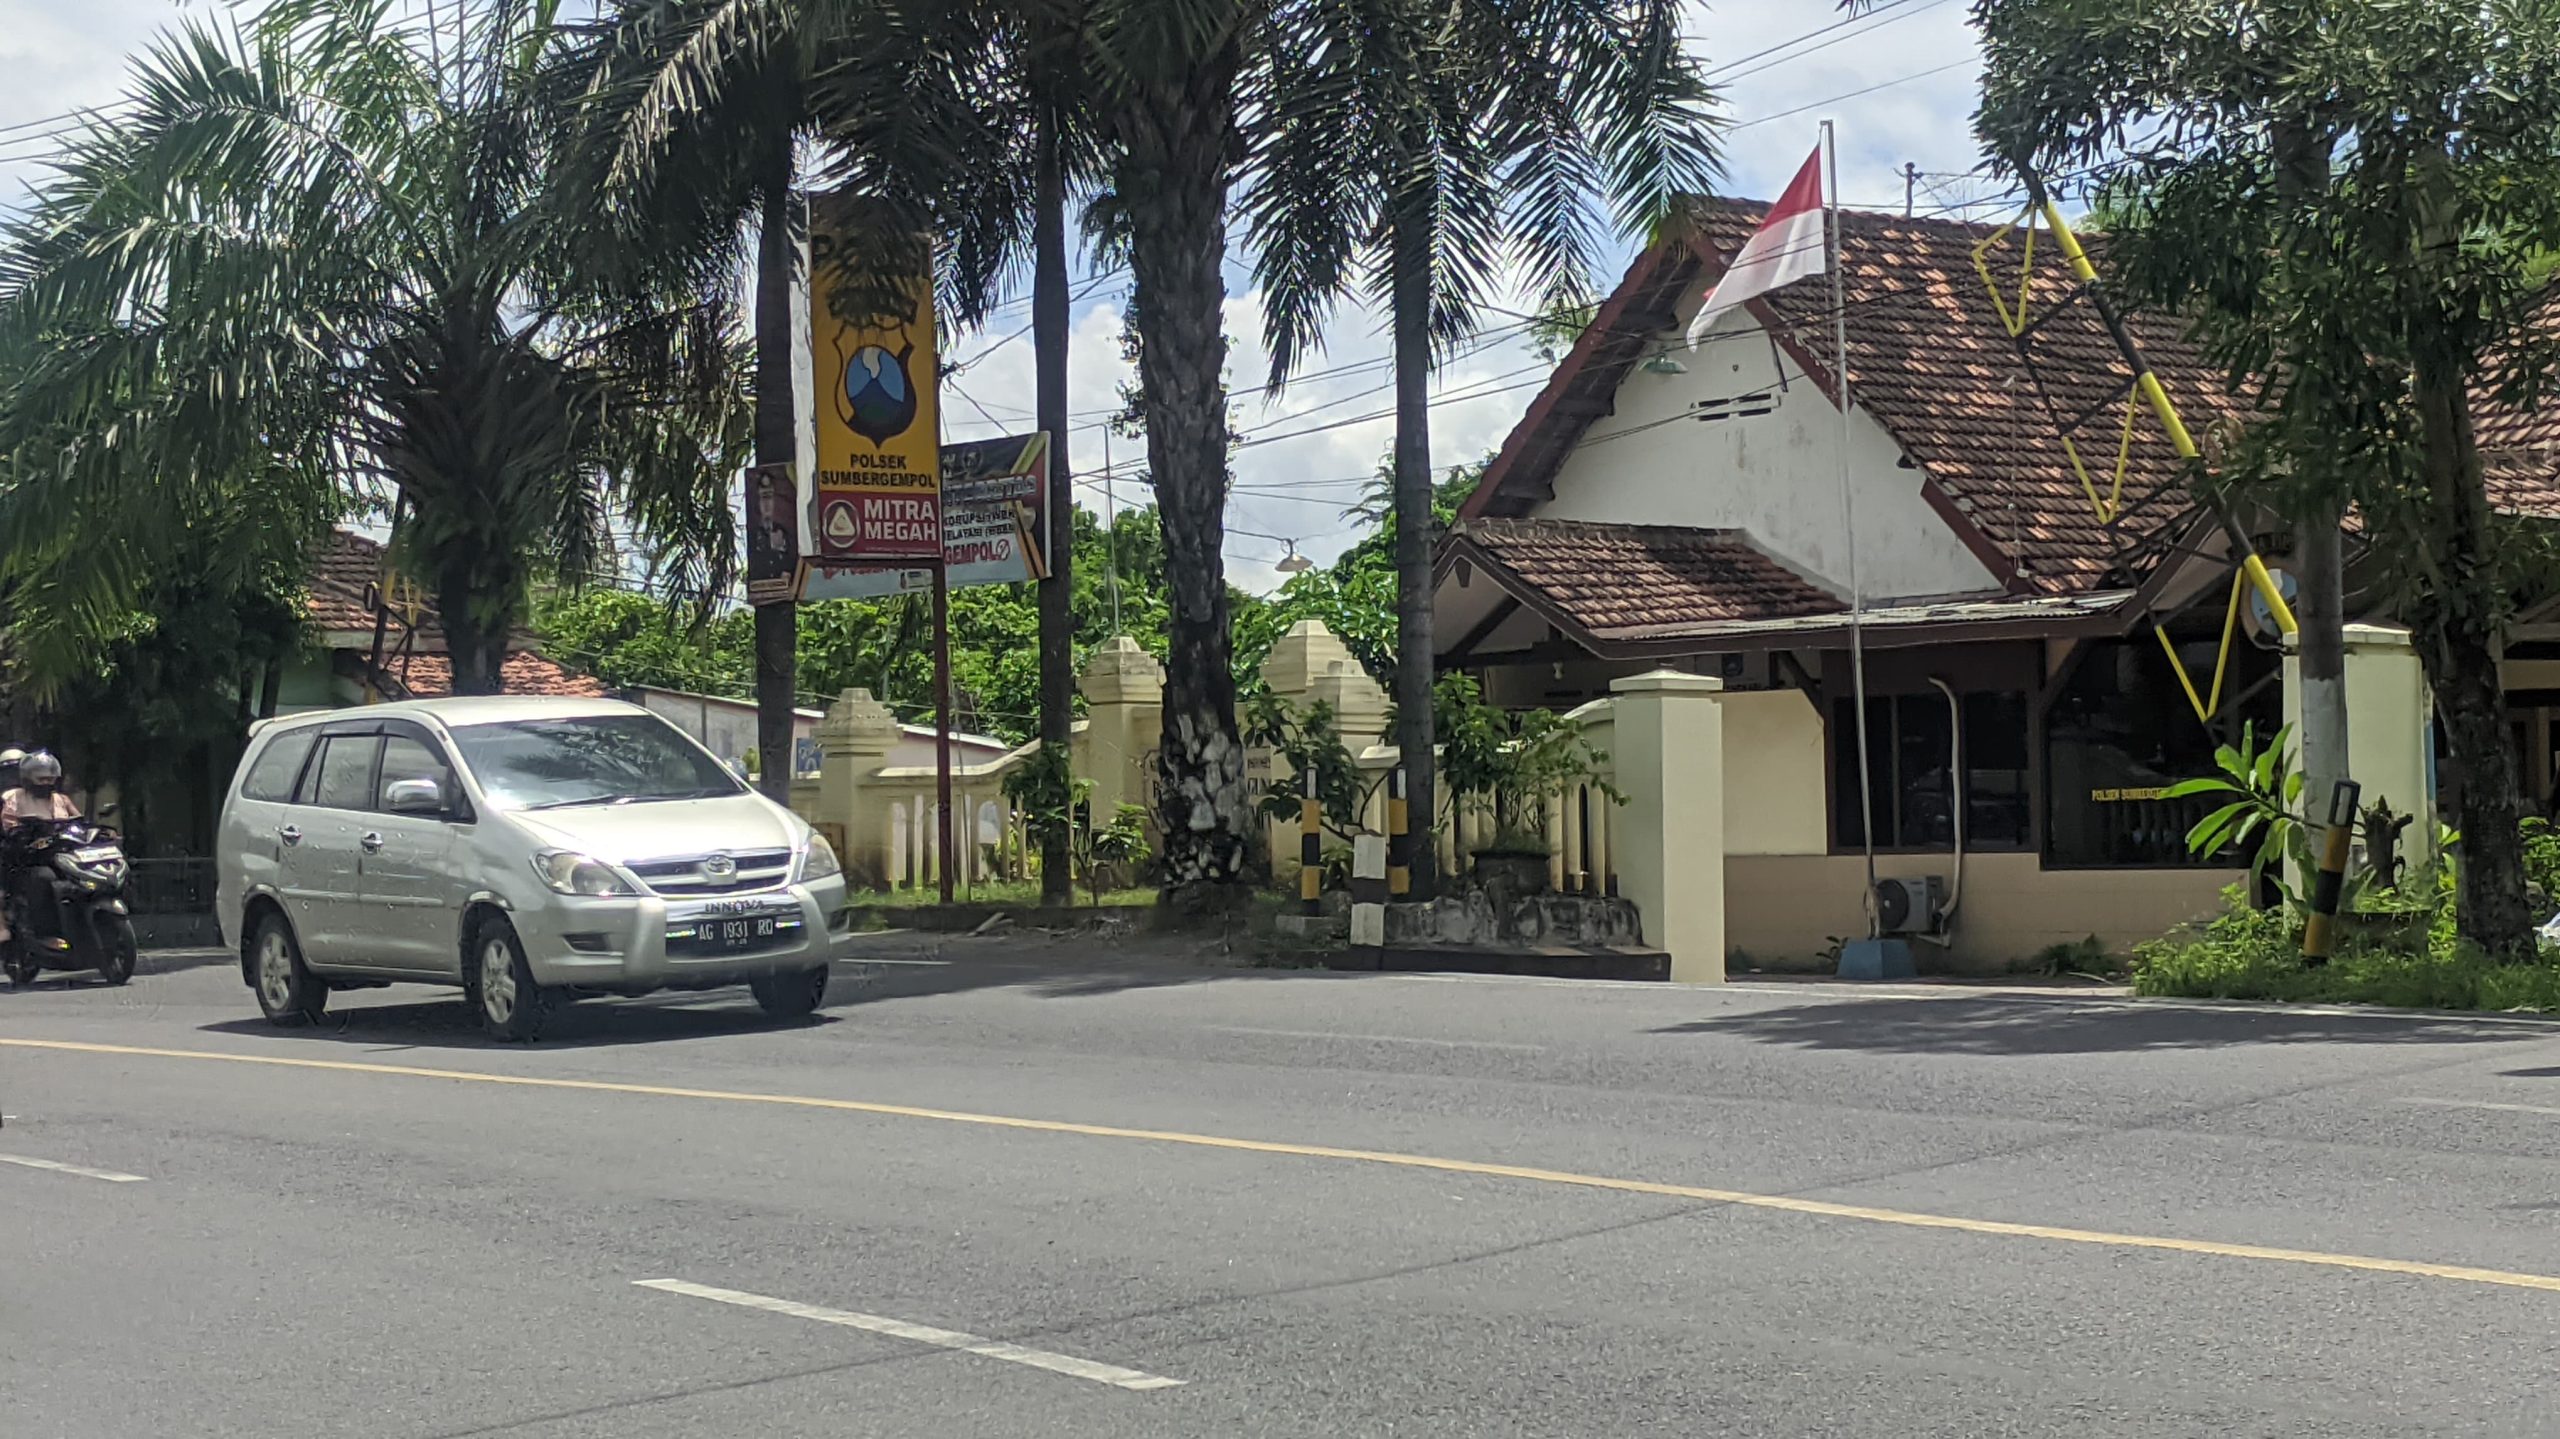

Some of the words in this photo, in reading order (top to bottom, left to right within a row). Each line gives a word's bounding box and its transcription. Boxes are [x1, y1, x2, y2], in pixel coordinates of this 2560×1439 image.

[850, 454, 907, 470] POLSEK
[821, 471, 936, 488] SUMBERGEMPOL
[864, 499, 936, 521] MITRA
[865, 522, 937, 541] MEGAH
[699, 923, 714, 940] AG
[723, 921, 748, 938] 1931
